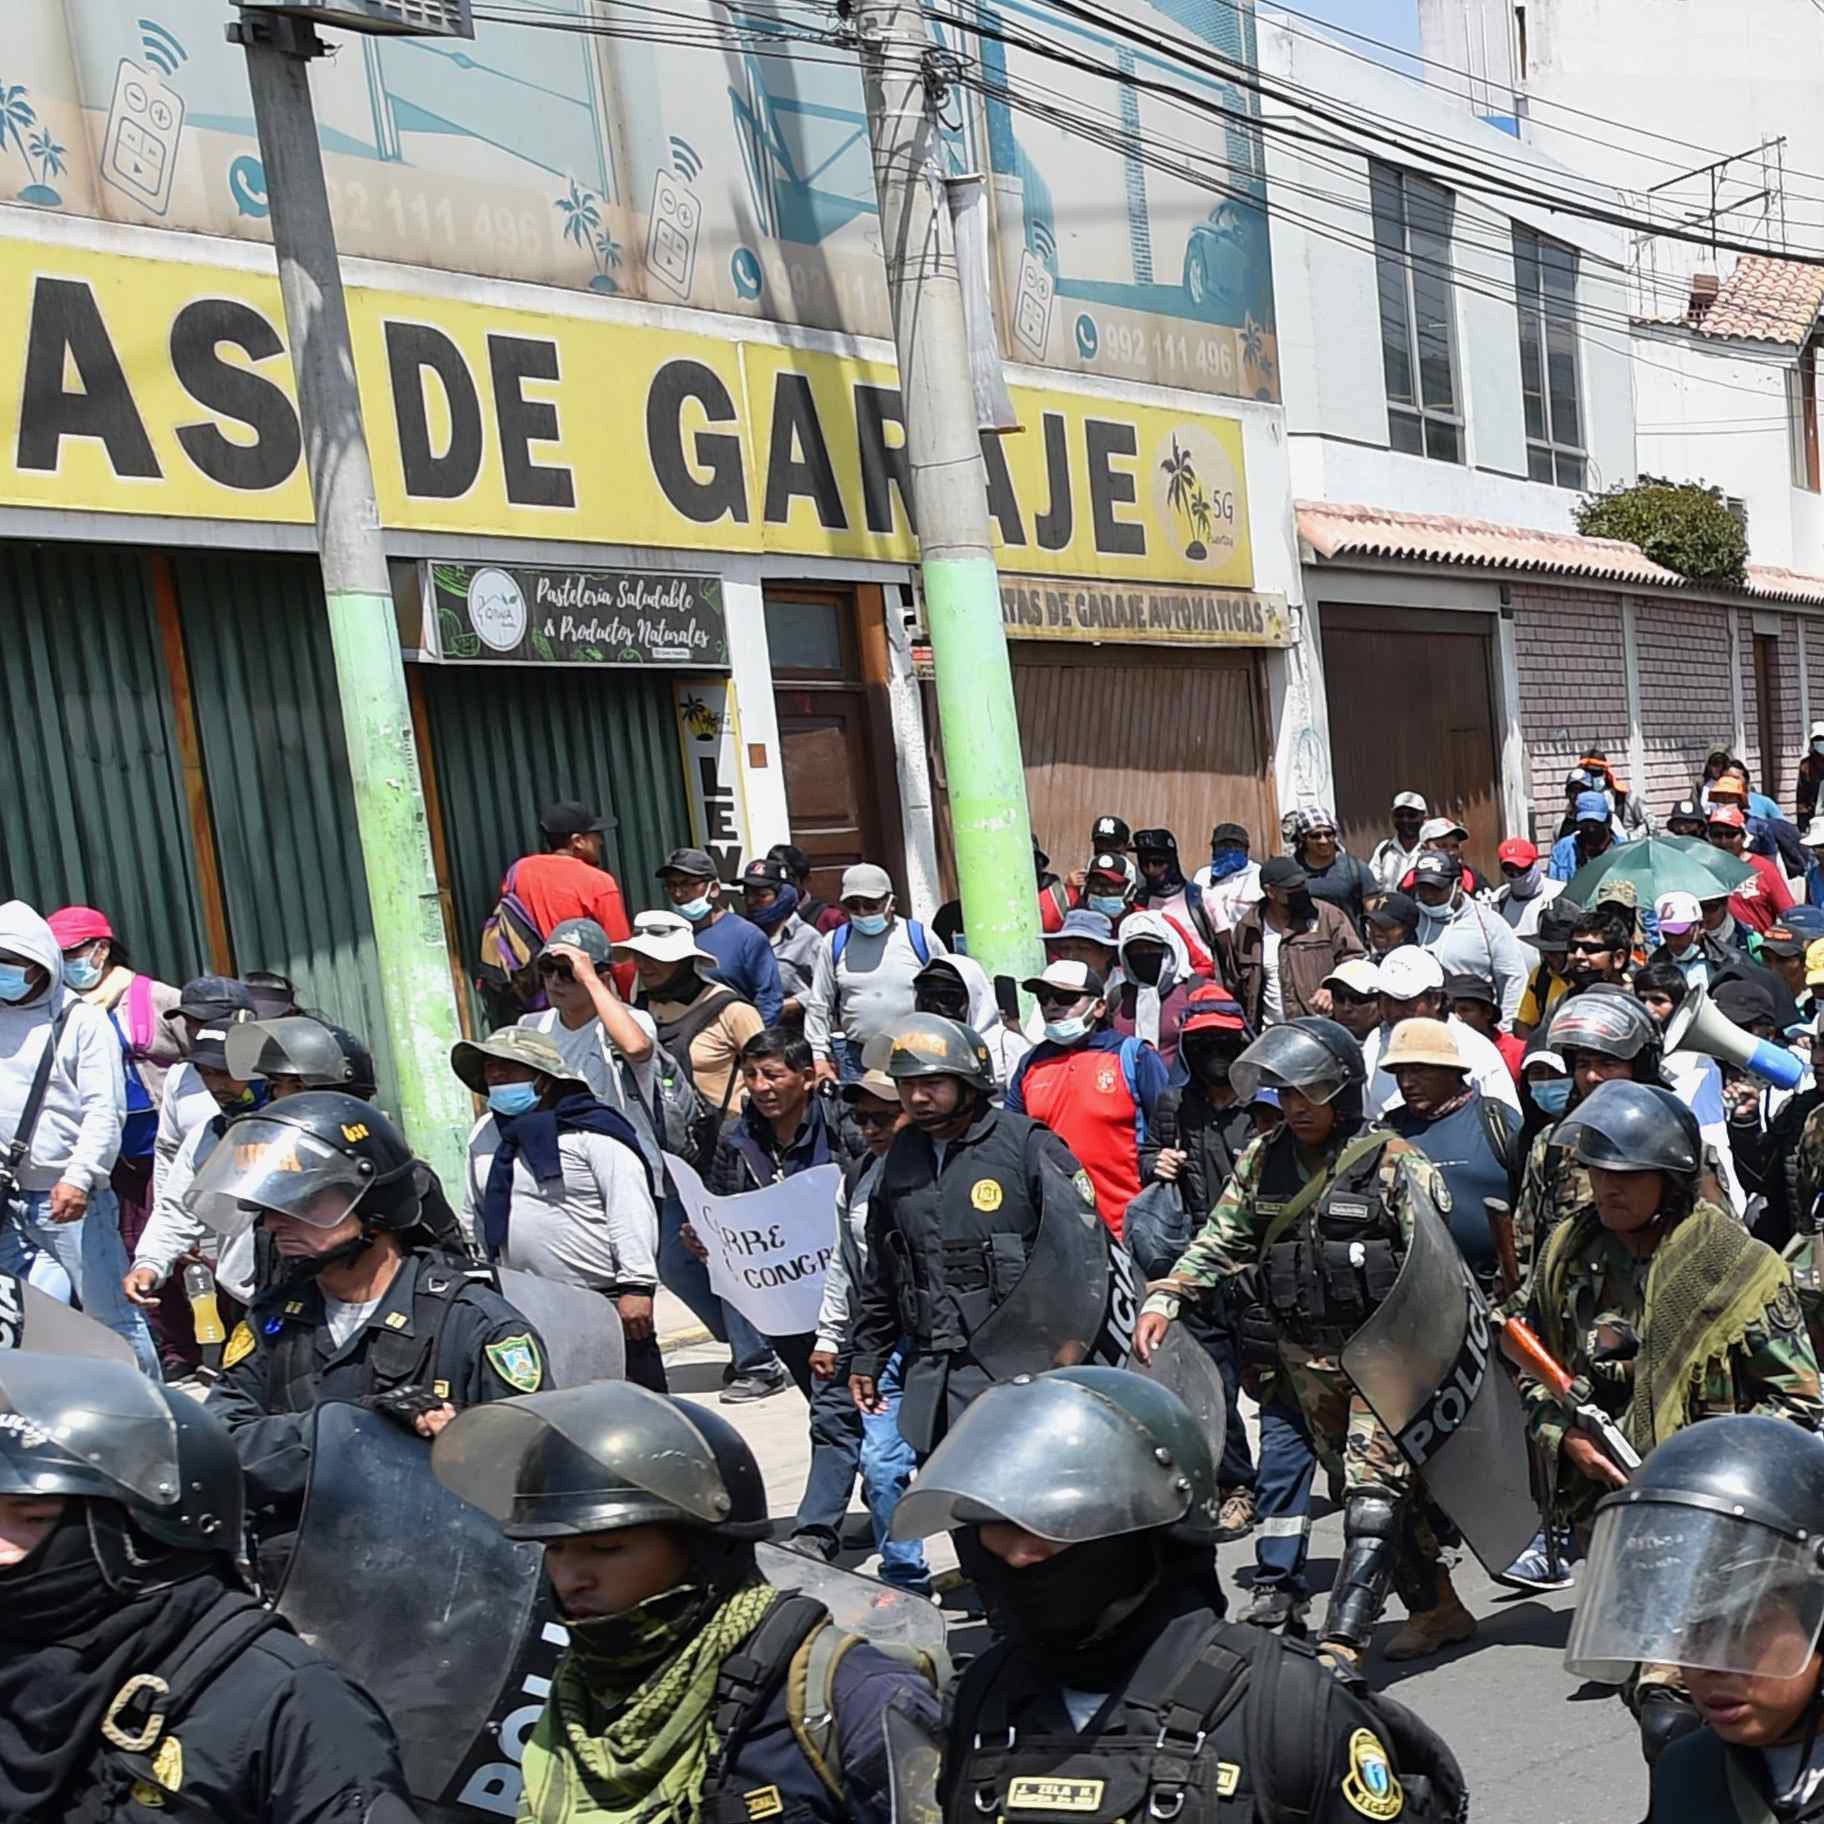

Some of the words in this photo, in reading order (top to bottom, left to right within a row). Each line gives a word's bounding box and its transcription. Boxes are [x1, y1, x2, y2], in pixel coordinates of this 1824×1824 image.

[1105, 321, 1147, 365] 992
[1154, 329, 1188, 372] 111
[1197, 341, 1233, 378] 496
[15, 276, 302, 492] AS
[382, 319, 576, 509] DE
[1211, 490, 1234, 524] 5G
[616, 575, 695, 612] Saludable
[1046, 591, 1072, 627] DE
[1074, 592, 1147, 630] GARAJE
[559, 614, 635, 648] Productos
[636, 618, 710, 649] Naturales
